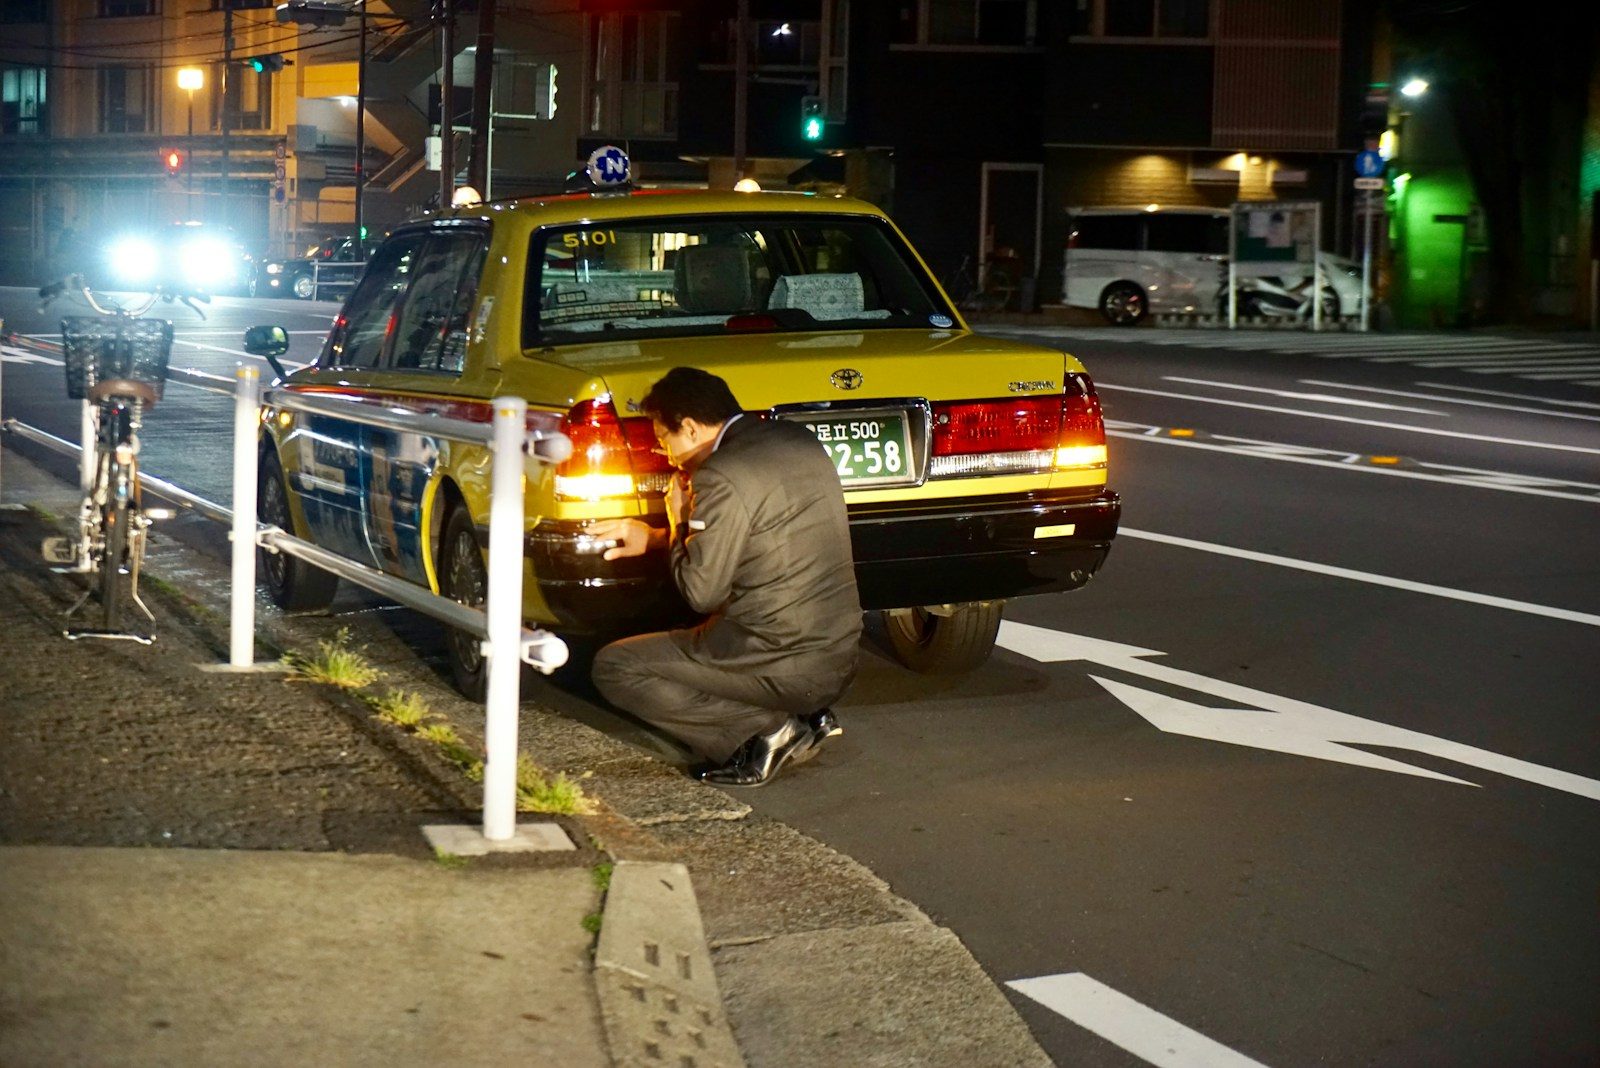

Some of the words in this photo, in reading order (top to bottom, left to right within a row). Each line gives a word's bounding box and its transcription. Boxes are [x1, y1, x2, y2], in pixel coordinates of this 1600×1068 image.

[606, 157, 624, 174] N
[563, 230, 616, 248] 5101
[1008, 381, 1056, 392] CROWN
[823, 440, 901, 476] 2-58
